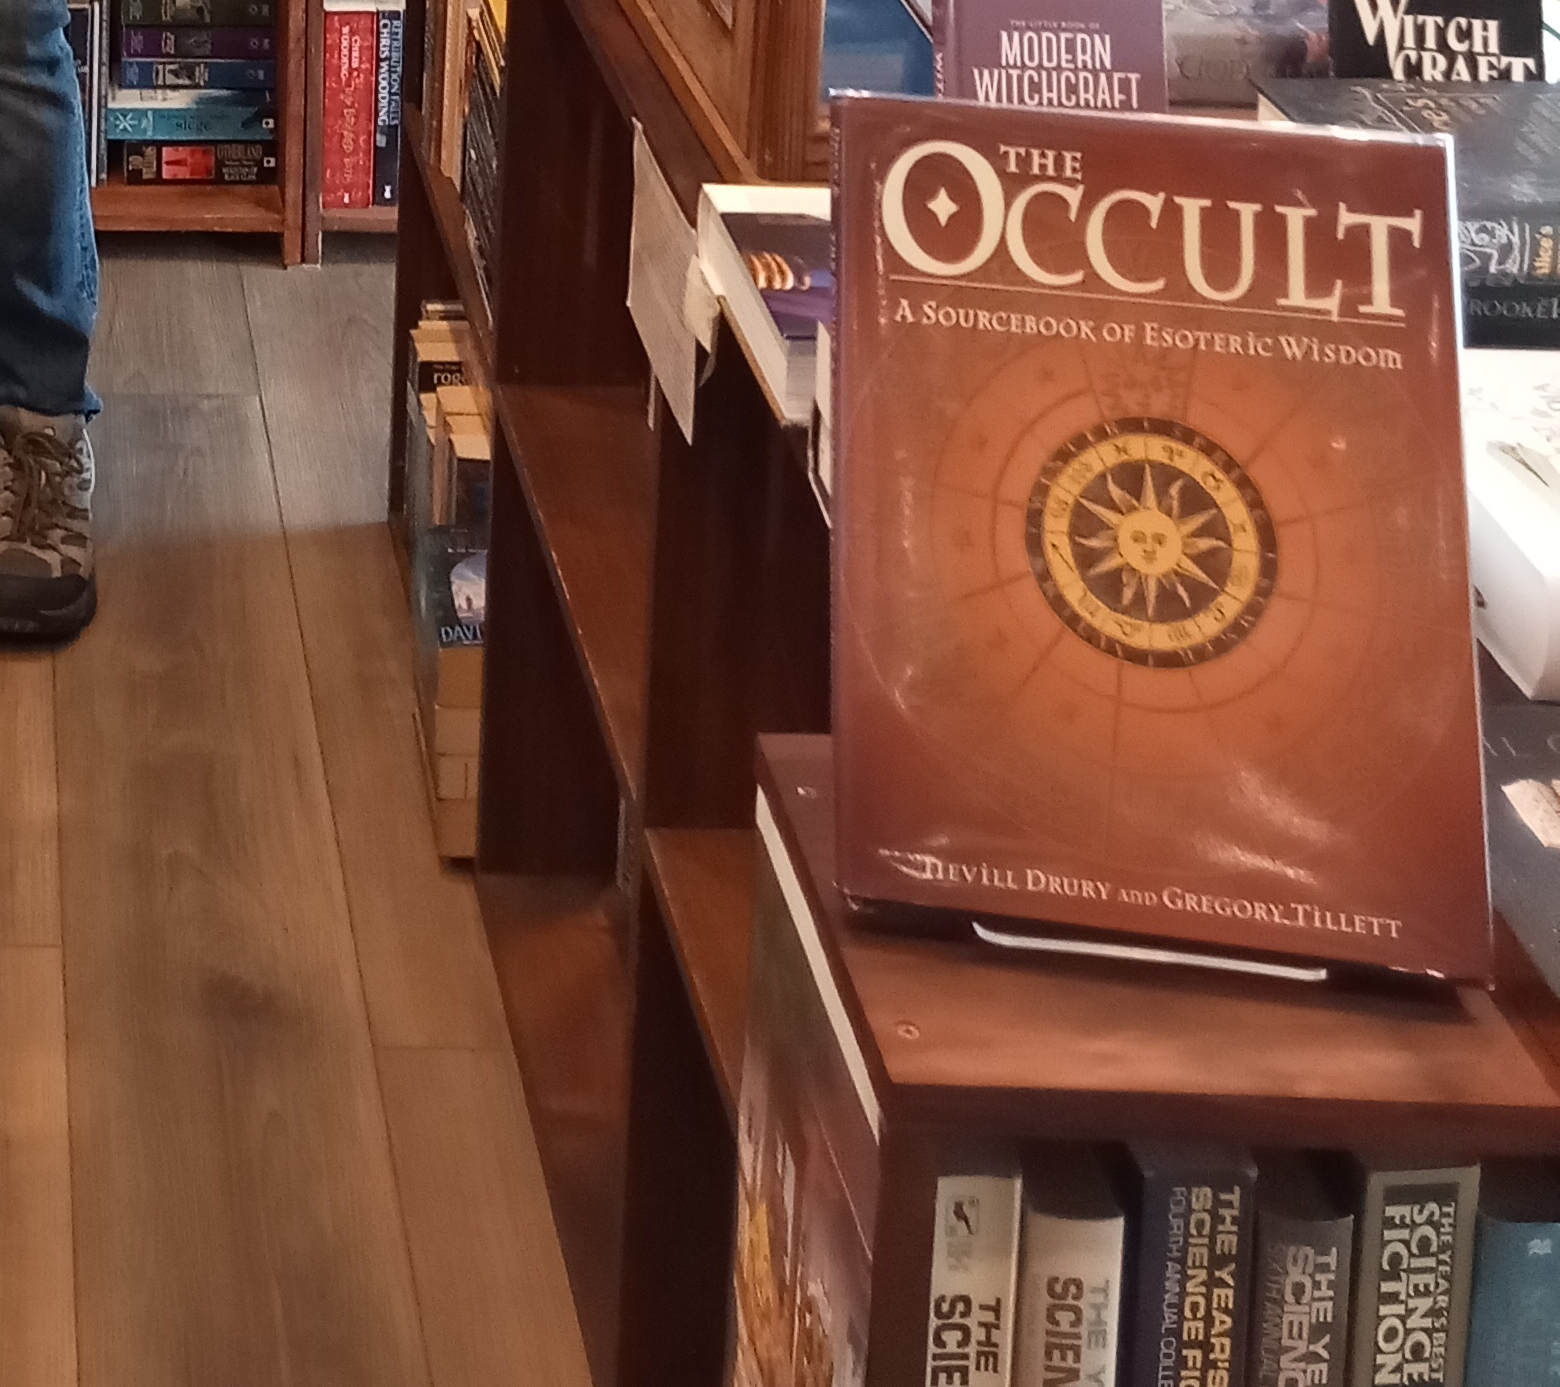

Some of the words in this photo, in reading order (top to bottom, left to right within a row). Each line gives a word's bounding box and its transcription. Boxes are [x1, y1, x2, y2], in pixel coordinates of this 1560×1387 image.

[379, 19, 391, 58] CHRIS
[999, 30, 1112, 70] MODERN
[1395, 50, 1537, 82] CRAFT
[378, 61, 390, 126] WOODING
[972, 67, 1142, 109] WITCHCRAFT
[999, 143, 1084, 181] THE
[880, 140, 1423, 321] OCCULT
[894, 298, 917, 324] A
[1025, 869, 1111, 901] DRURY
[1161, 886, 1285, 925] GREGORY
[1291, 902, 1402, 939] TILLETT
[1167, 1187, 1187, 1258] FOURTH
[1216, 1185, 1240, 1255] THE
[1437, 1202, 1456, 1245] THE
[1161, 1261, 1181, 1333] ANNUAL
[1182, 1186, 1212, 1341] SCIENCE
[1311, 1247, 1337, 1323] THE
[1374, 1205, 1413, 1386] FICTION
[1403, 1201, 1440, 1385] SCIENCE
[1432, 1250, 1451, 1328] YEAR'S
[974, 1297, 1001, 1373] THE
[1087, 1279, 1109, 1350] THE
[1429, 1332, 1447, 1383] BEST
